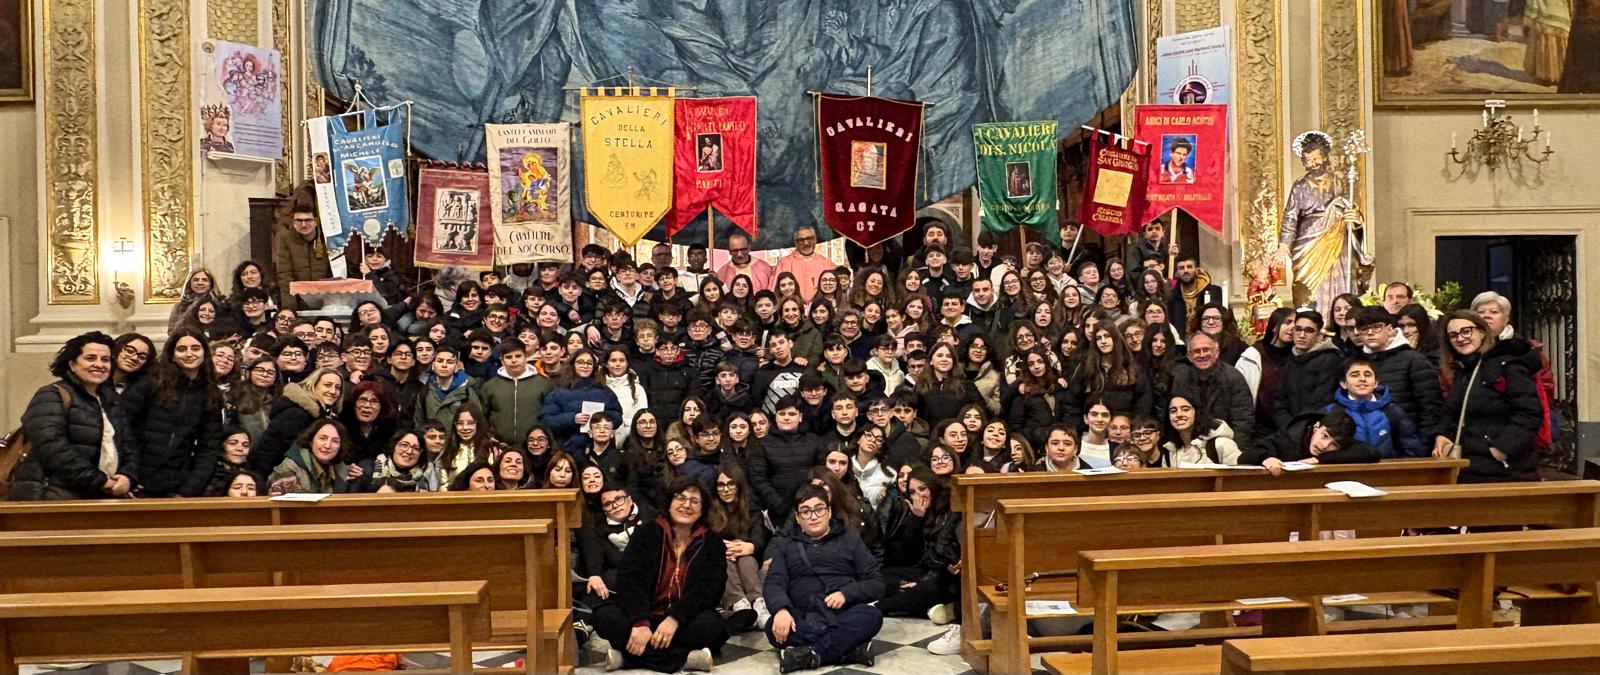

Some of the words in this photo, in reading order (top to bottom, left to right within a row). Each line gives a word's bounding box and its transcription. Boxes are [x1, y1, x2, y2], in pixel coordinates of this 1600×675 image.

[590, 105, 668, 125] CAVALIERI
[1171, 116, 1191, 126] CARLO
[618, 124, 645, 133] DELLA
[826, 117, 913, 142] CAVALIERI
[986, 123, 1057, 140] CAVALIERI
[334, 134, 381, 145] CAVALIERI
[604, 138, 652, 149] STELLA
[1008, 139, 1057, 155] NICOLA
[340, 148, 381, 159] MICHELE
[1097, 157, 1112, 166] SAN
[609, 210, 655, 219] CENTURIPE
[625, 222, 636, 230] EN
[856, 221, 875, 231] CT
[509, 230, 551, 244] CAVALIERI
[496, 246, 512, 255] DEL
[518, 244, 570, 254] SOCCORSO
